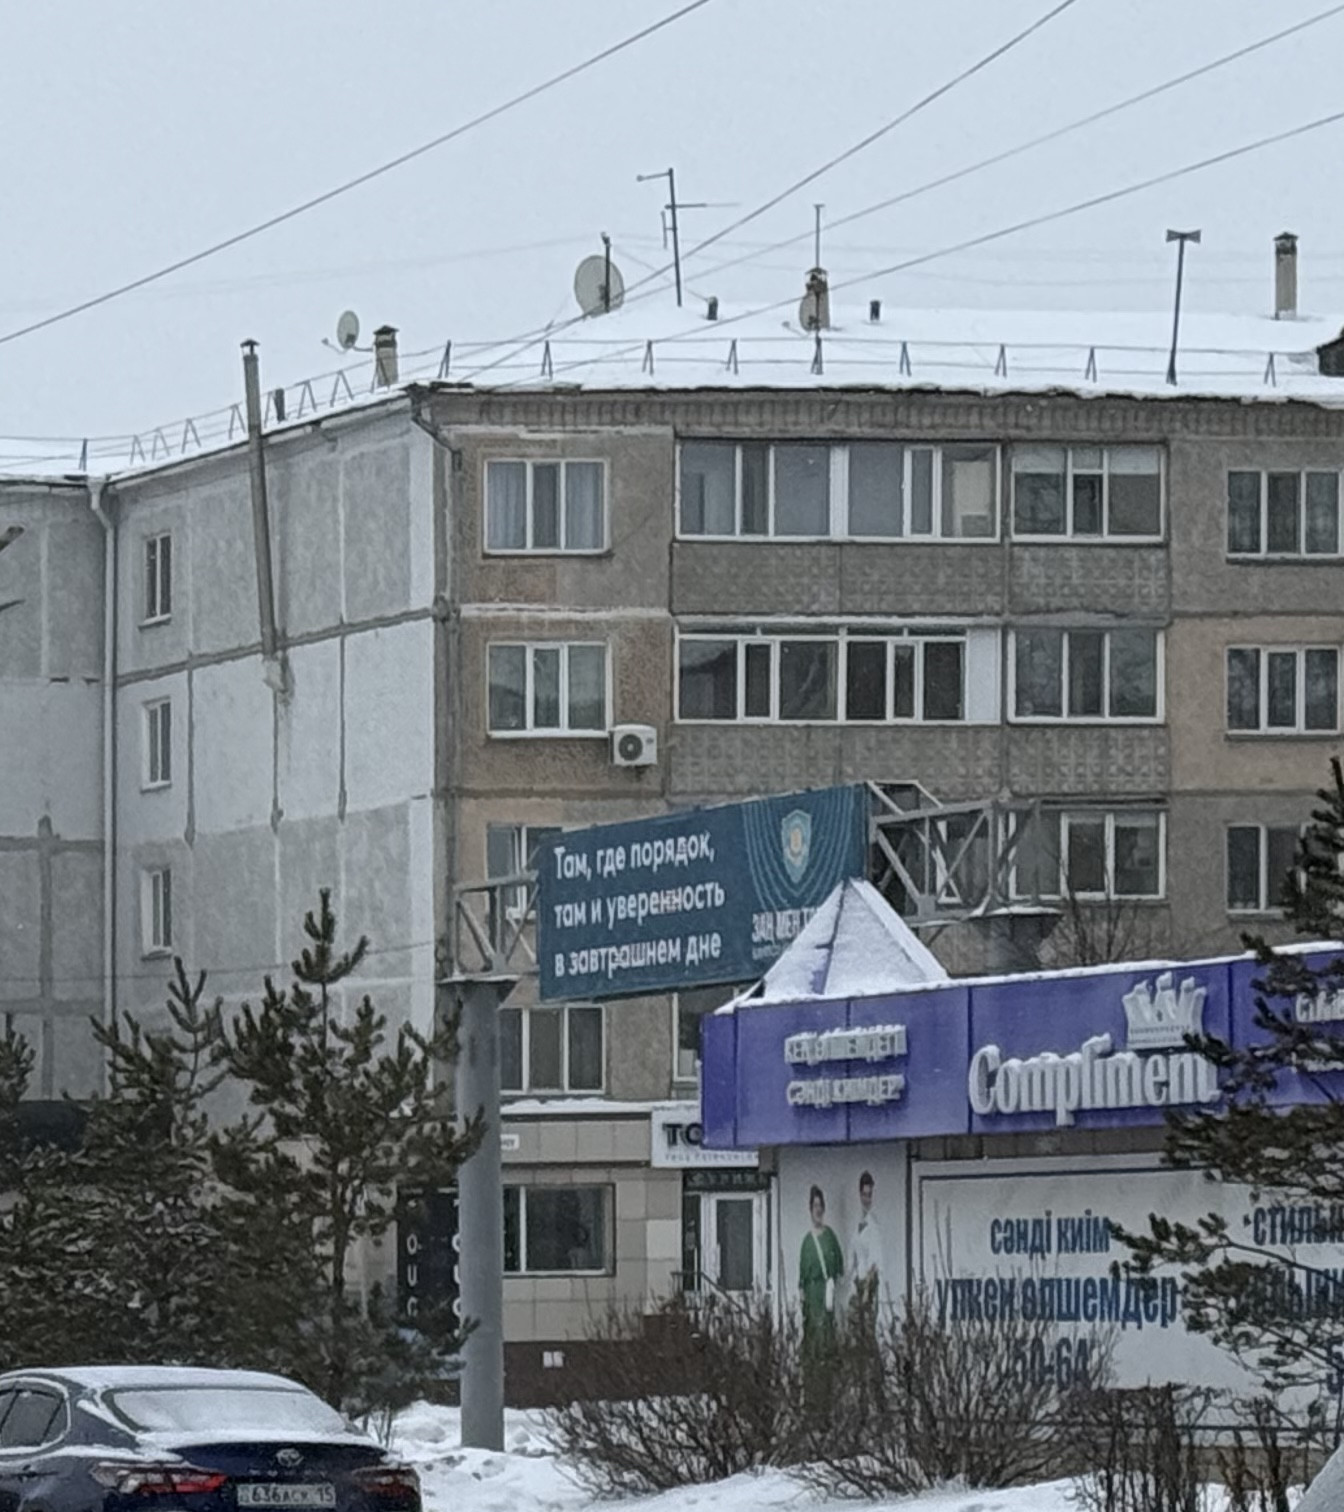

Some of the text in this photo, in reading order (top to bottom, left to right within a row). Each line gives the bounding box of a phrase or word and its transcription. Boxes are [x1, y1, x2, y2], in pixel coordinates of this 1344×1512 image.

[554, 831, 715, 881] Там, где порядок,
[554, 882, 725, 930] там и уверенность
[554, 954, 564, 977] в
[568, 939, 681, 979] завтрашнем
[685, 931, 722, 964] дне
[969, 1032, 1221, 1126] Compliment
[990, 1208, 1111, 1260] сәнді киім
[1021, 1275, 1177, 1329] өлшемдер
